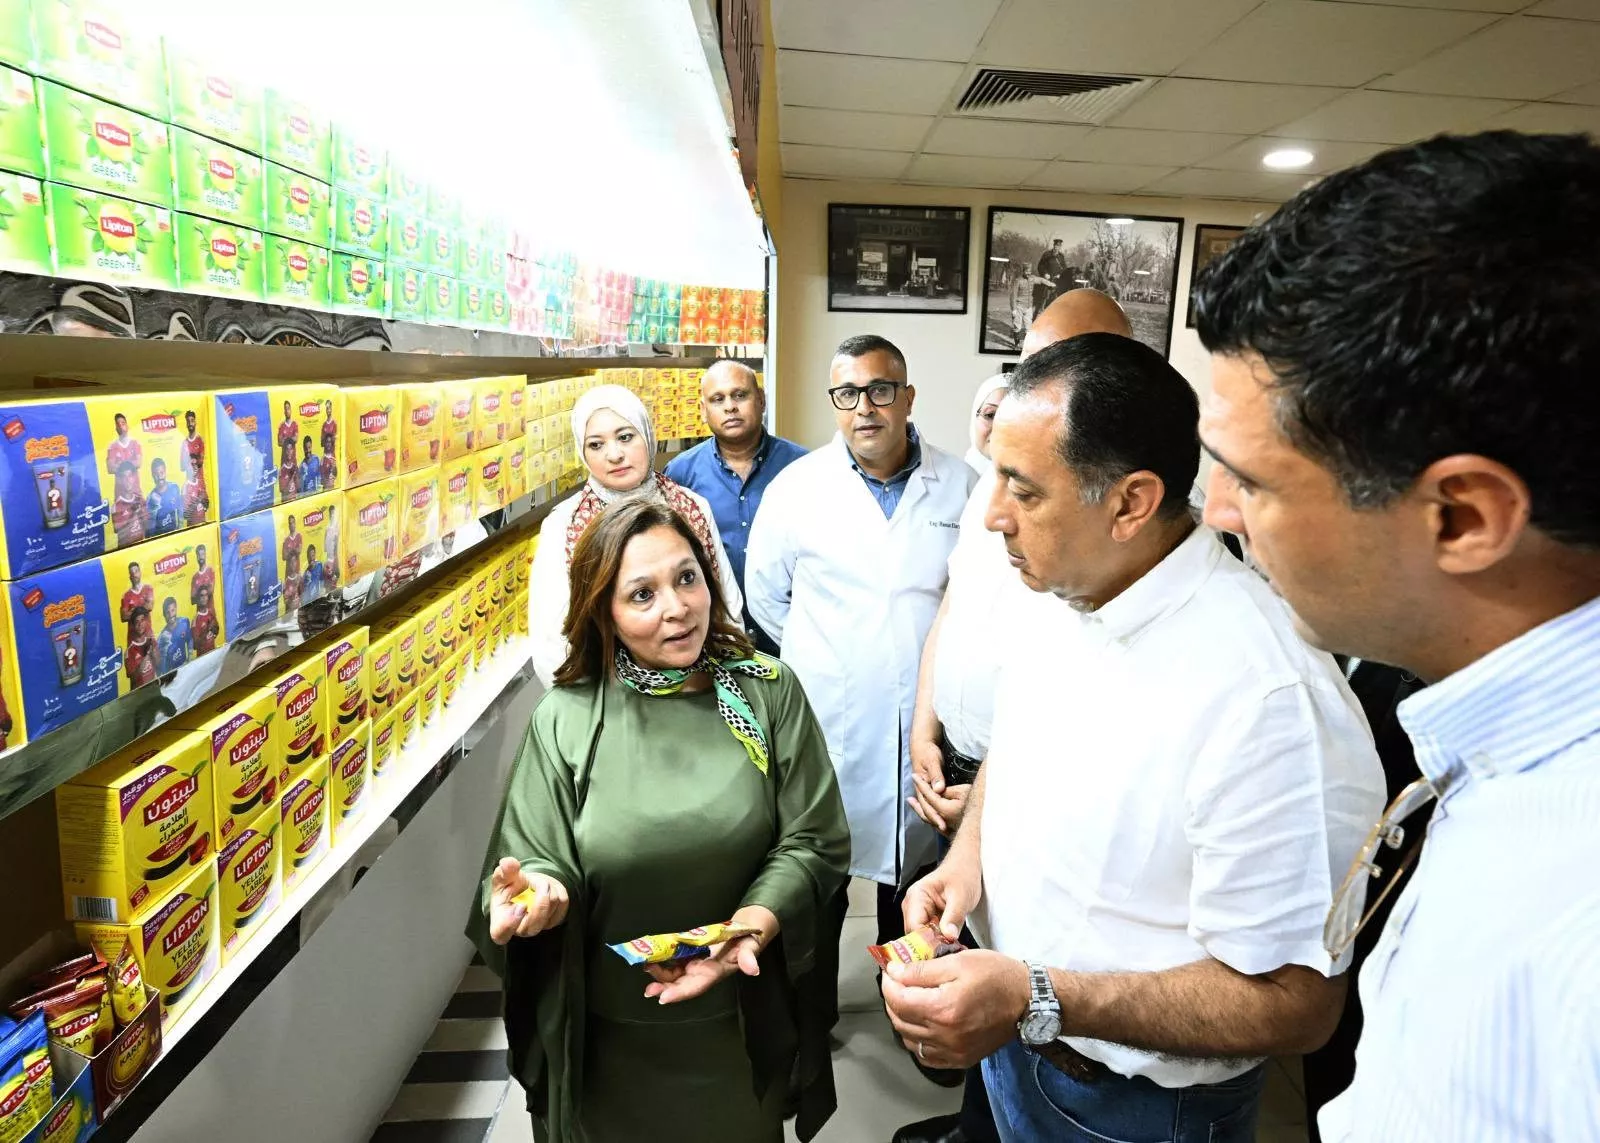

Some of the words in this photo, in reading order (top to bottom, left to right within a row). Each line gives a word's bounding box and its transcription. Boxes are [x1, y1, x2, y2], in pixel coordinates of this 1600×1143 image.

[102, 218, 133, 234] Lipton
[213, 241, 235, 254] Lipton
[143, 417, 175, 430] LIPTON
[361, 416, 387, 430] LIPTON
[155, 555, 186, 573] LIPTON
[340, 655, 362, 681] ليبتون
[288, 687, 317, 717] ليبتون
[231, 716, 247, 729] عبوة
[232, 726, 267, 761] ليبتون
[241, 752, 262, 773] العلامة
[343, 750, 366, 775] LIPTON
[147, 768, 167, 784] عبوة
[121, 778, 147, 801] توفير
[148, 777, 196, 821] ليبتون
[295, 789, 323, 822] LIPTON
[159, 808, 189, 833] العلامة
[159, 816, 190, 844] الصفراء
[299, 810, 321, 833] YELLOW
[301, 821, 320, 840] LABEL
[239, 831, 252, 844] Pack
[237, 839, 272, 878] LIPTON
[241, 861, 270, 890] YELLOW
[245, 874, 266, 897] LABEL
[145, 911, 168, 933] Saving
[168, 895, 184, 912] Pack
[165, 900, 208, 949] LIPTON
[172, 925, 205, 963] YELLOW
[176, 941, 201, 969] LABEL
[53, 1011, 99, 1037] LIPTON
[121, 1022, 146, 1052] LIPTON
[120, 1035, 147, 1066] KARAK
[28, 1055, 50, 1078] TON
[0, 1081, 31, 1115] IPTON
[44, 1099, 74, 1137] LIPTON
